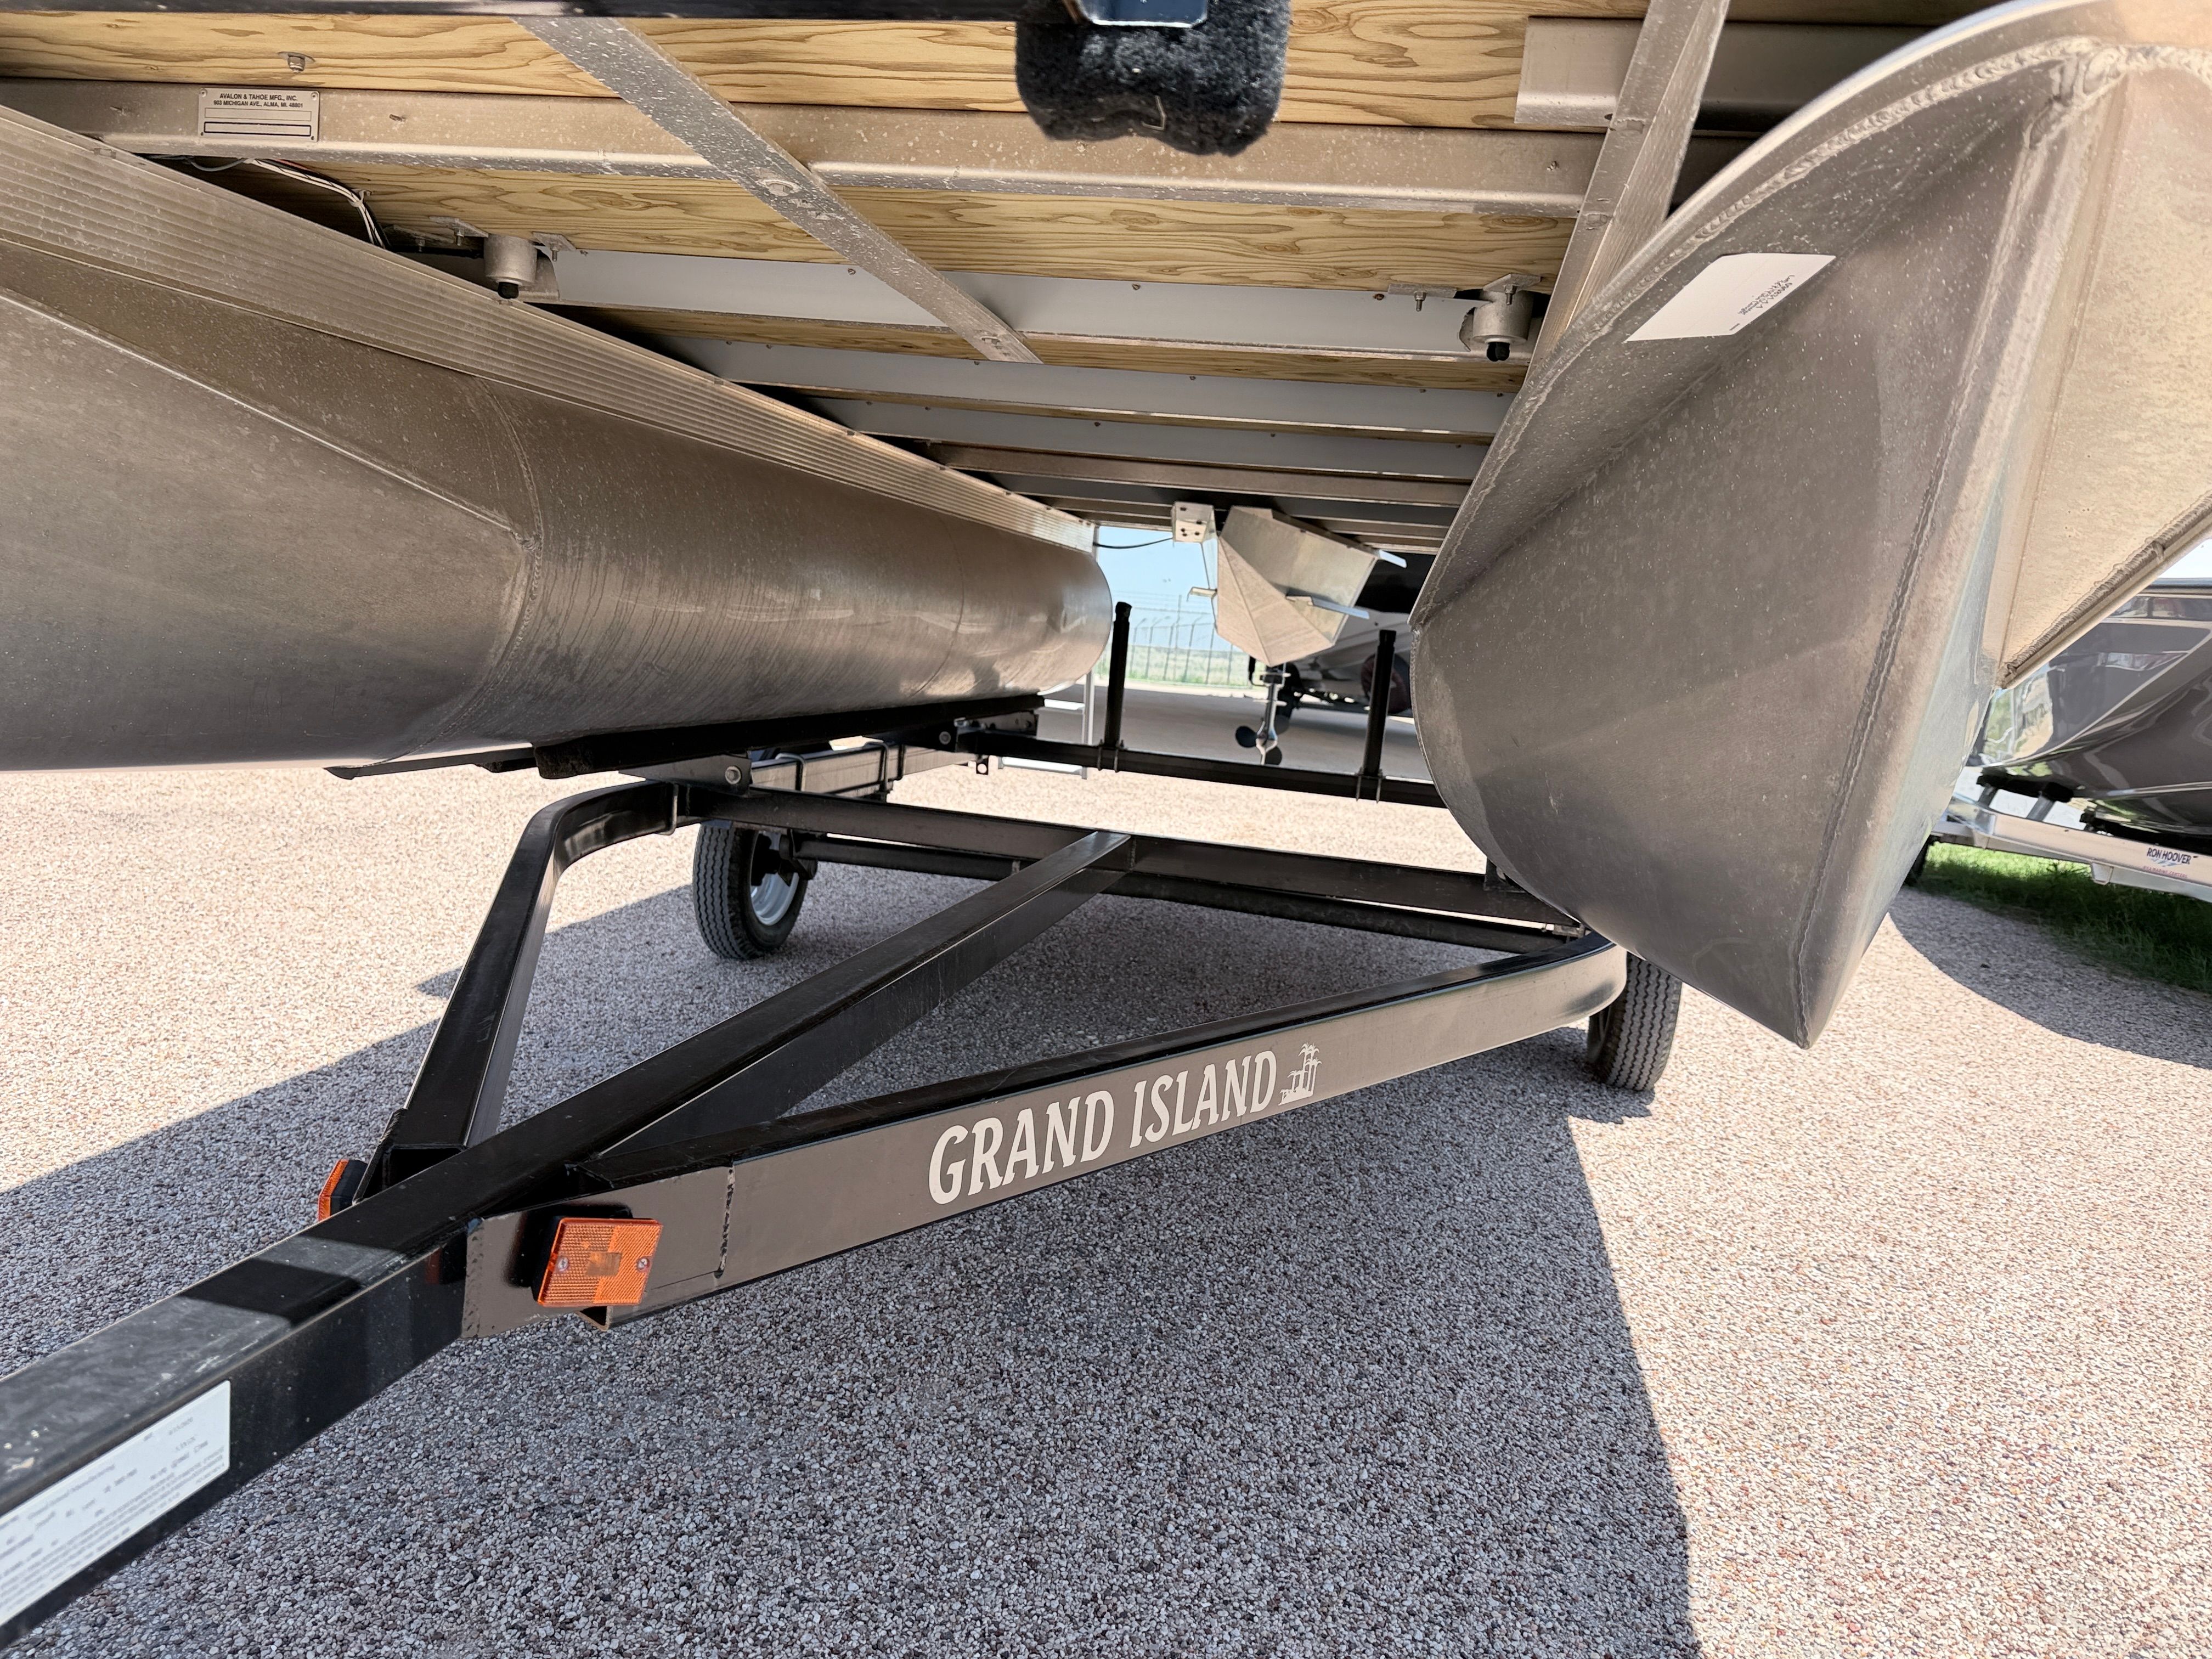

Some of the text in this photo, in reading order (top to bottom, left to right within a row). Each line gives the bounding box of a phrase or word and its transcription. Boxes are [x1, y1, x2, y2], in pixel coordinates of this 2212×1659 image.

[2146, 848, 2191, 864] RON HOOVER
[928, 1051, 1278, 1204] GRAND ISLAND
